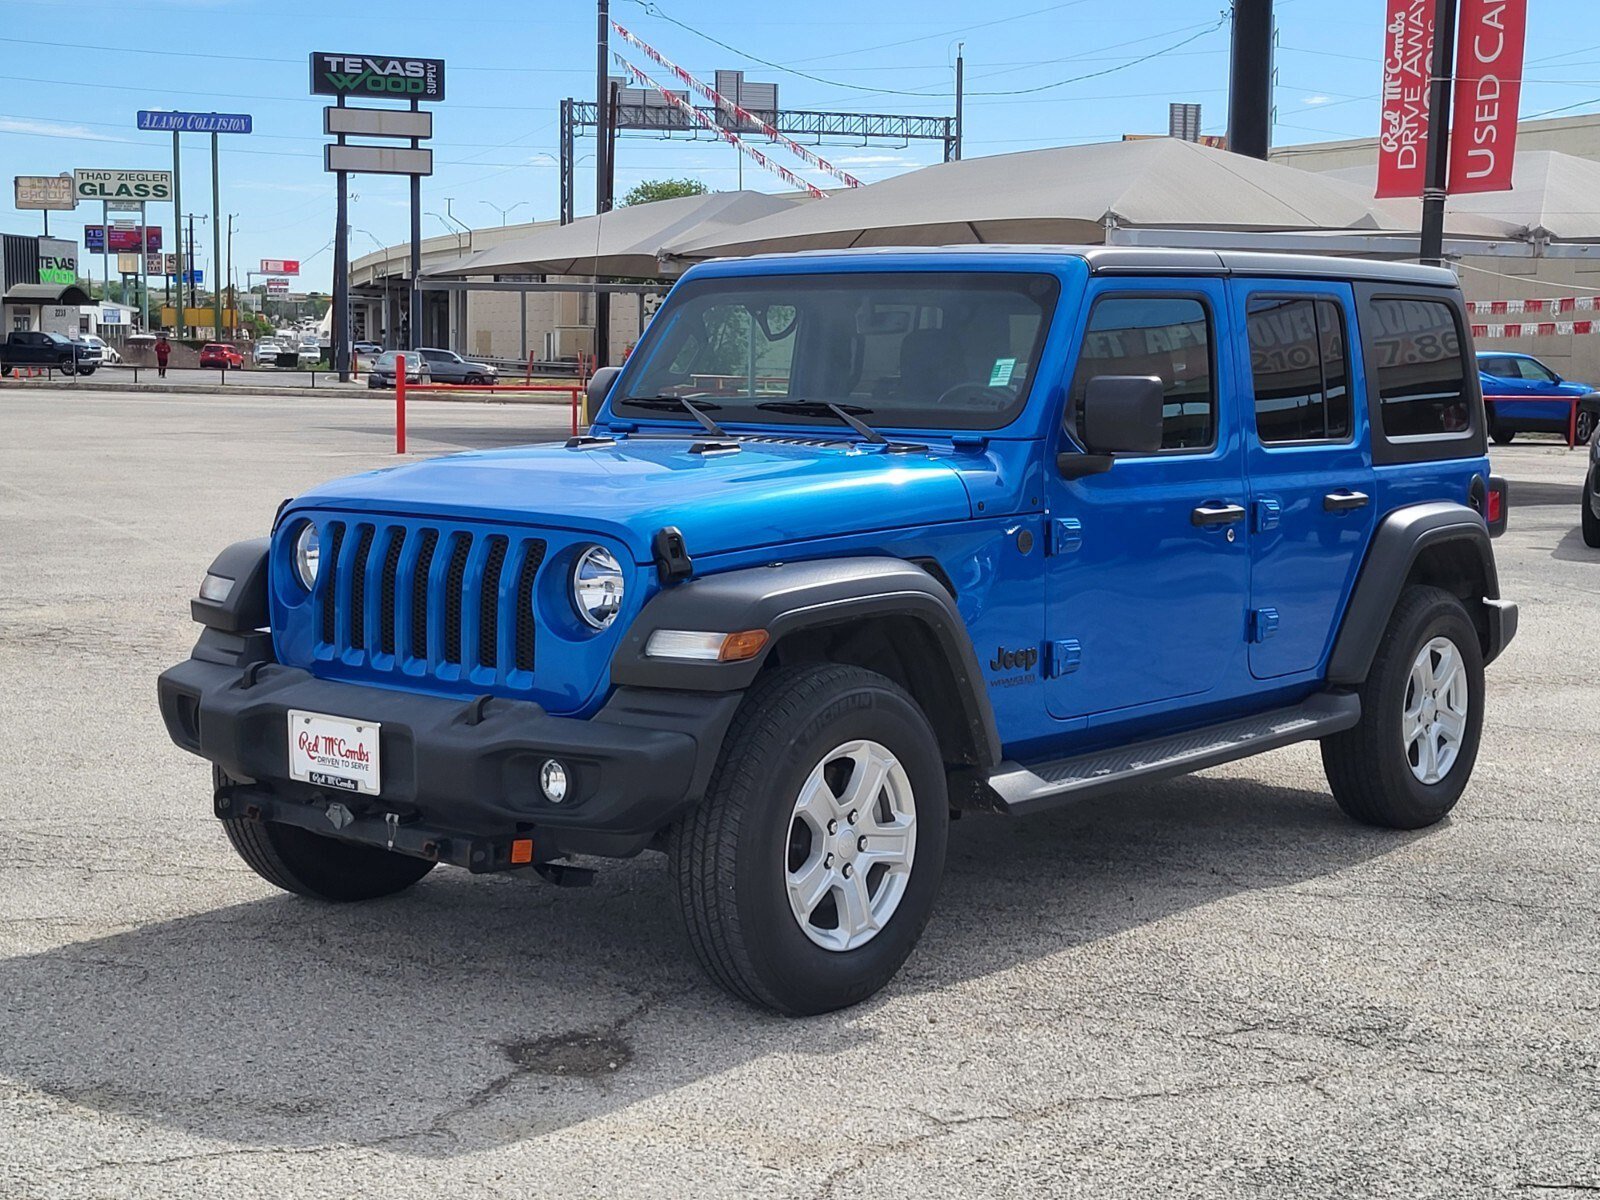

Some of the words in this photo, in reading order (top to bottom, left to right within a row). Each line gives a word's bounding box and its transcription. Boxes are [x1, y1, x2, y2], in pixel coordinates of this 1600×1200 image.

[324, 56, 425, 77] TEXAS
[426, 62, 437, 95] SUPPLY
[324, 70, 425, 94] WOOD
[140, 112, 184, 129] ALAMO
[186, 113, 249, 132] COLLISION
[1381, 109, 1406, 153] Red
[1398, 85, 1421, 170] DRIVE
[1466, 74, 1500, 179] USED
[78, 172, 112, 180] THAD
[117, 173, 169, 182] ZIEGLER
[78, 182, 169, 198] GLASS
[39, 255, 75, 270] TEXAS
[989, 645, 1038, 672] Jeep
[299, 731, 319, 760] Red
[321, 736, 369, 762] McCombs
[317, 756, 340, 767] DRIVEN
[341, 759, 350, 768] TO
[351, 762, 369, 772] SERVE
